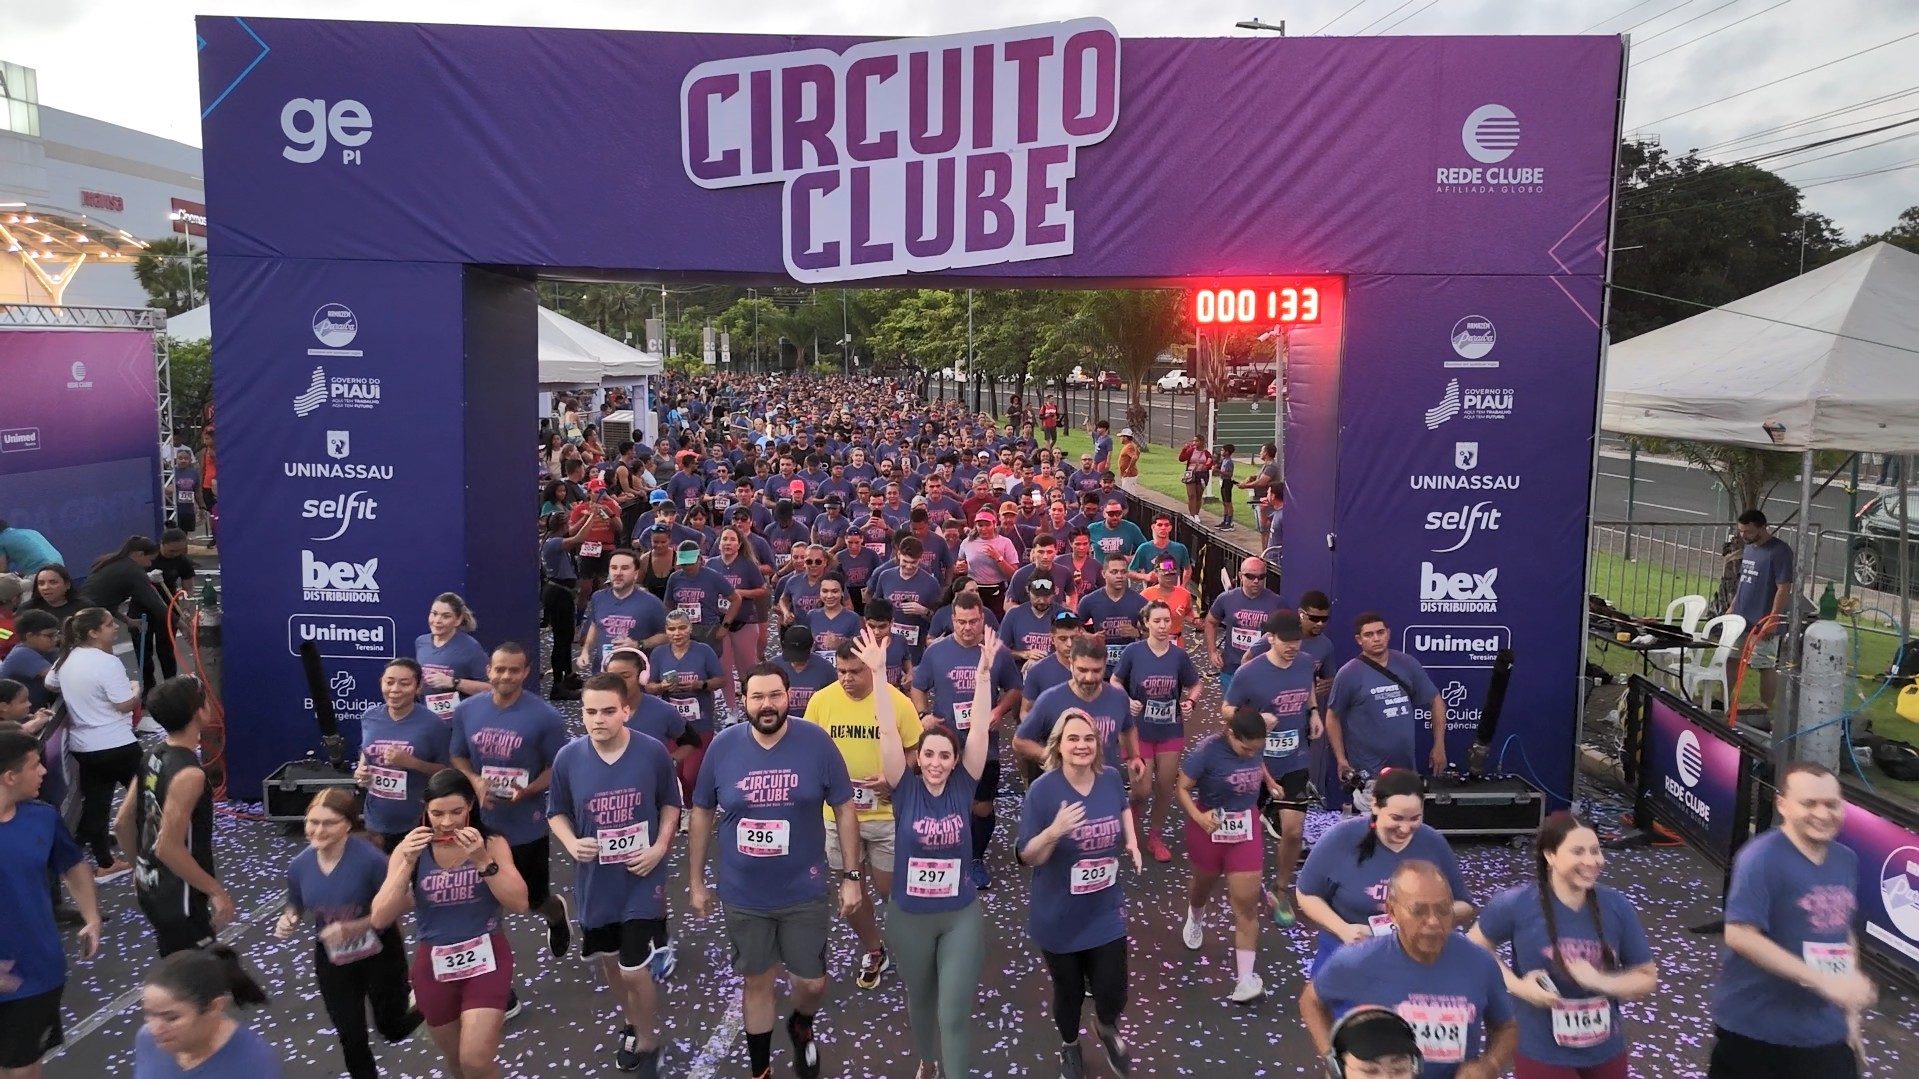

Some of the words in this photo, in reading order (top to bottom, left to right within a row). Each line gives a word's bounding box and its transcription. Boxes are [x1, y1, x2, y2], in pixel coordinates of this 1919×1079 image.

[688, 29, 1117, 180] CIRCUITO
[281, 98, 373, 163] ge
[343, 149, 361, 165] PI
[1436, 167, 1483, 184] REDE
[1486, 167, 1544, 184] CLUBE
[790, 144, 1069, 270] CLUBE
[4, 432, 36, 444] Unimed
[284, 462, 394, 480] UNINASSAU
[1410, 475, 1520, 489] UNINASSAU
[302, 490, 378, 541] selfit
[1424, 501, 1502, 553] selfit
[302, 549, 380, 589] bex
[1420, 561, 1498, 600] bex
[303, 591, 380, 603] DISTRIBUIDORA
[1420, 602, 1497, 613] DISTRIBUIDORA
[300, 624, 384, 642] Unimed
[1236, 634, 1252, 643] 478
[355, 643, 384, 651] Teresina
[1415, 635, 1499, 651] Unimed
[1269, 737, 1294, 747] 1753
[375, 776, 398, 788] 807
[742, 773, 799, 790] CIRCUITO
[590, 792, 641, 813] CIRCUITO
[752, 788, 790, 803] CLUBE
[1665, 774, 1685, 802] REDE
[1685, 790, 1710, 822] CLUBE
[599, 807, 635, 825] CLUBE
[917, 814, 964, 835] CIRCUITO
[608, 835, 636, 851] 207
[747, 829, 774, 843] 296
[918, 869, 946, 883] 297
[1081, 867, 1106, 881] 203
[434, 885, 476, 903] CLUBE
[445, 950, 477, 968] 322
